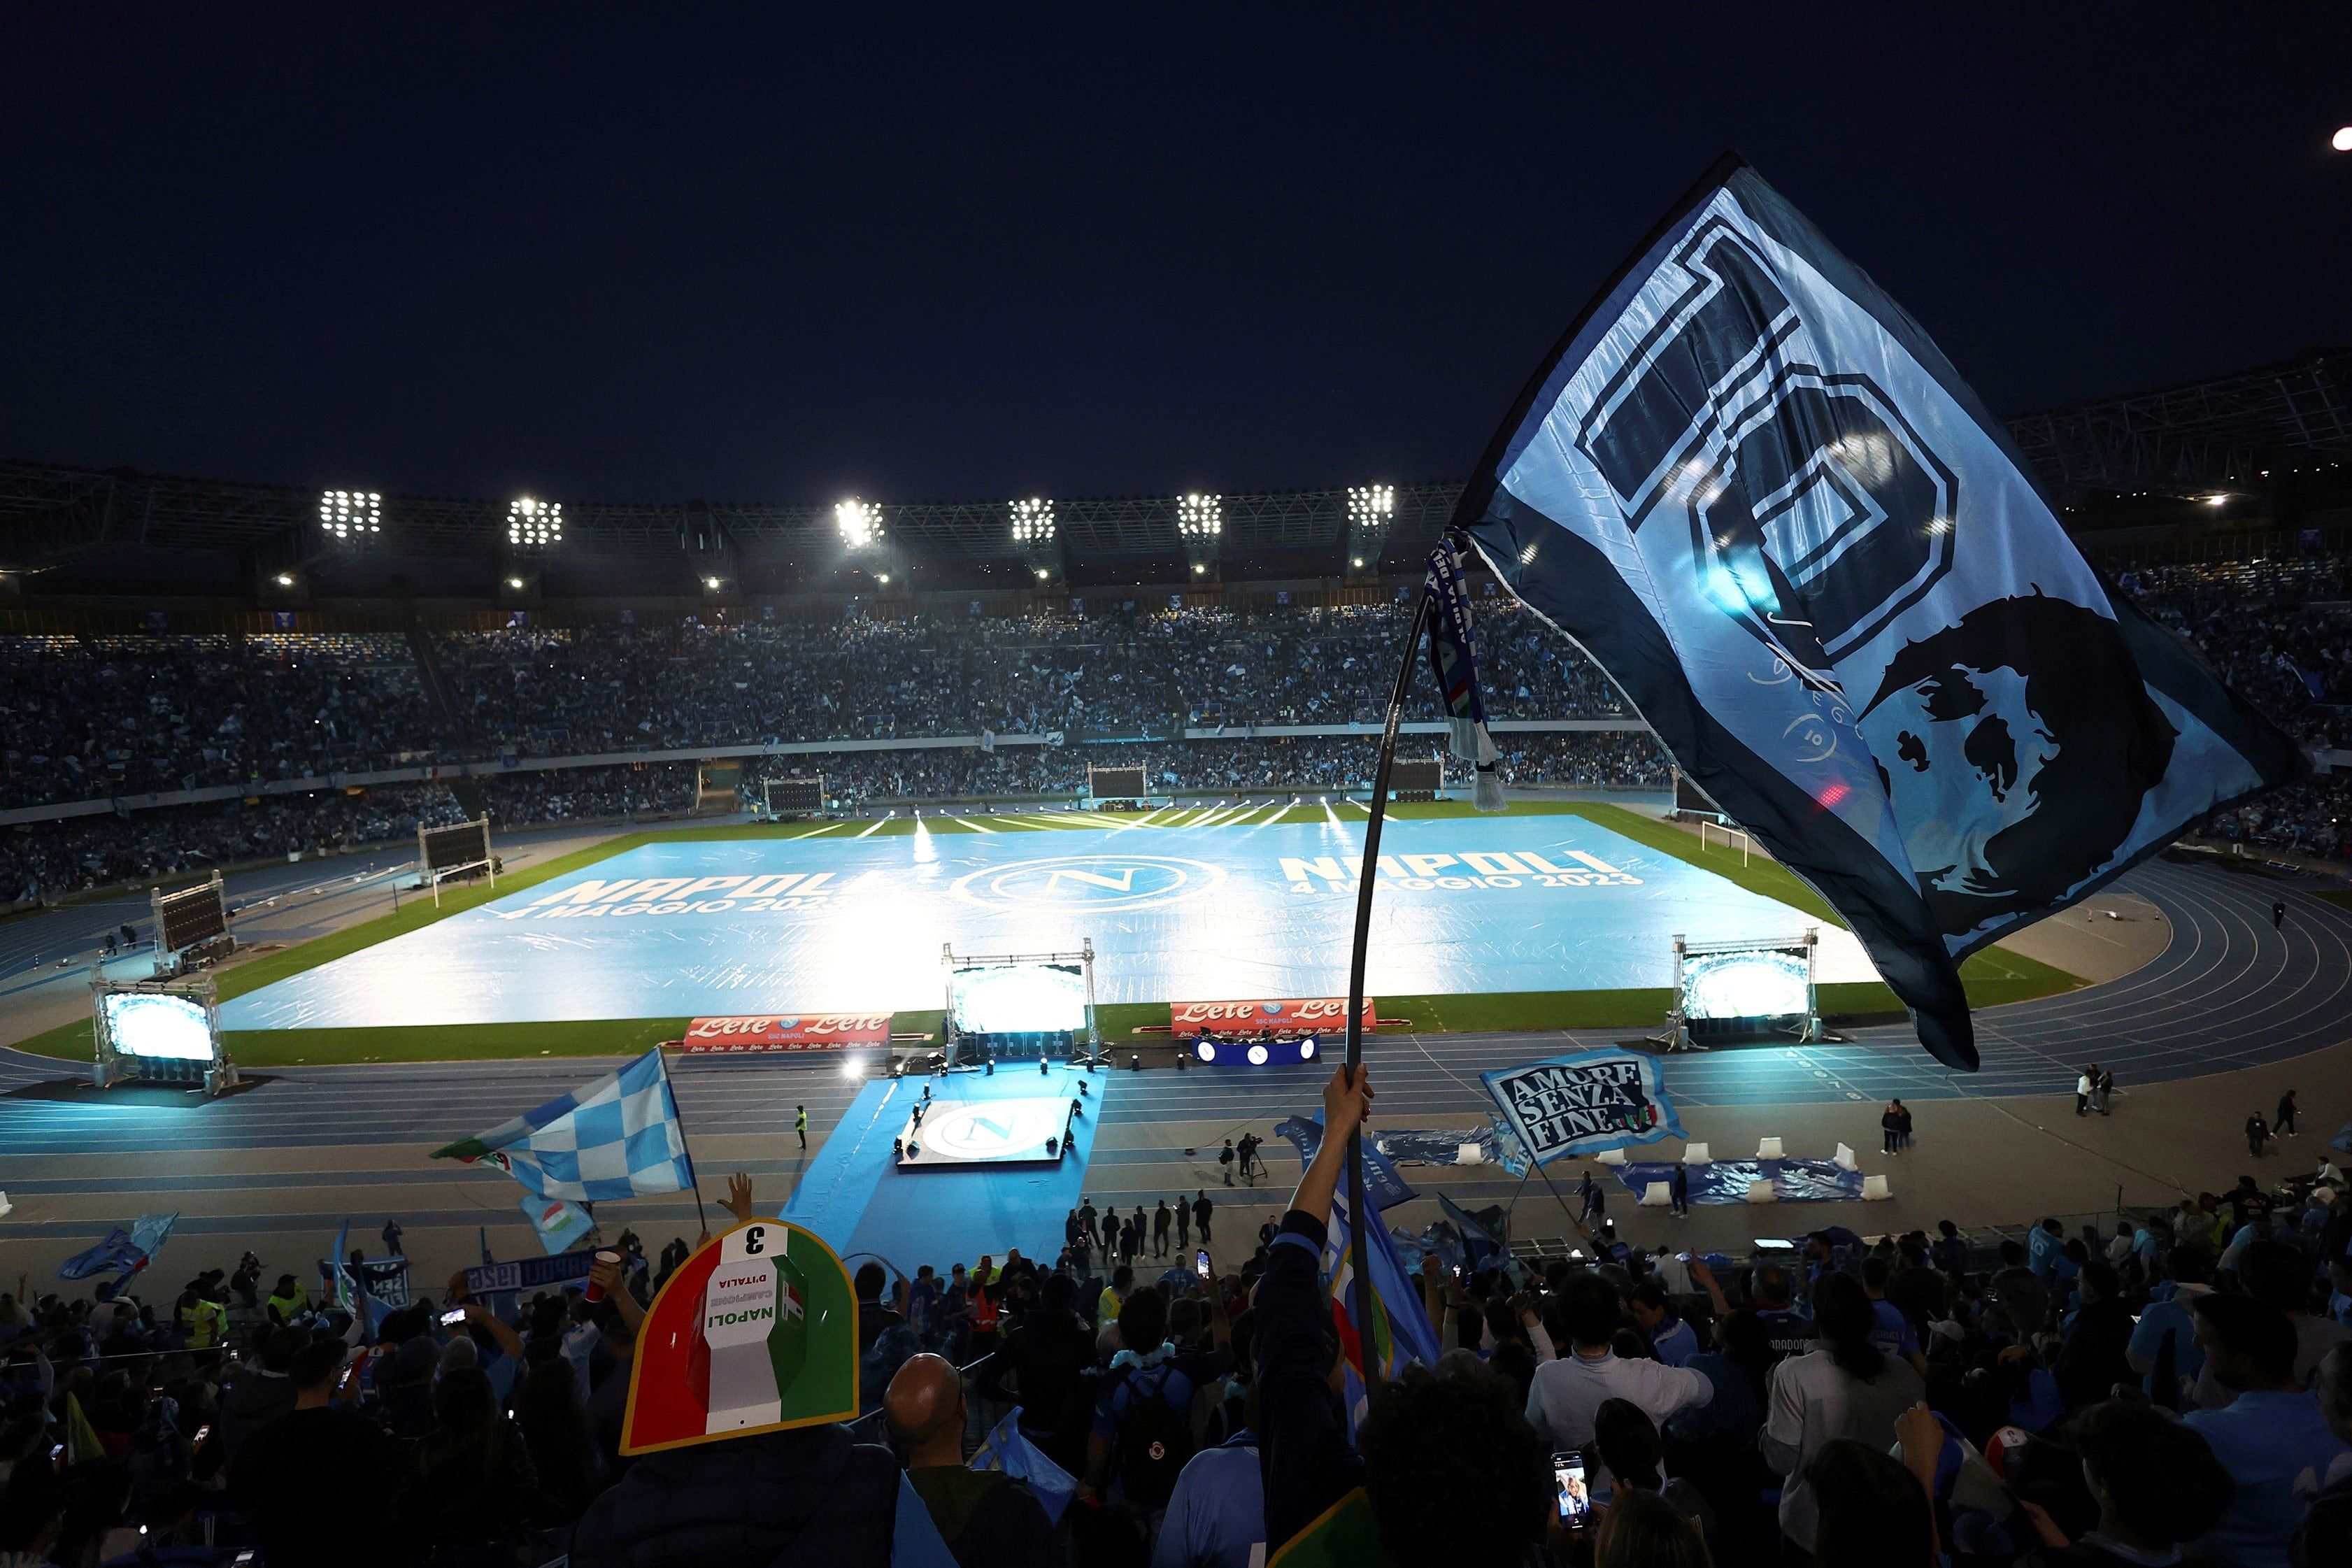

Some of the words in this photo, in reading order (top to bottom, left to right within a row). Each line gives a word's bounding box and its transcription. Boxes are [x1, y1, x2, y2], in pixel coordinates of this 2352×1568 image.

[1574, 213, 1960, 667] 10
[1278, 850, 1620, 882] NAPOLI
[530, 871, 884, 906] NAPOLI
[1290, 880, 1317, 895] 4
[1326, 874, 1523, 894] MAGGIO
[1532, 872, 1644, 888] 2023
[534, 899, 736, 920] MAGGIO
[689, 1017, 771, 1038] Lete
[804, 1013, 884, 1034] Lete
[1175, 1003, 1253, 1024] Lete
[1513, 1064, 1639, 1104] AMORE
[1518, 1083, 1636, 1125] SENZA
[964, 1117, 1015, 1141] N
[1529, 1108, 1613, 1149] FINE
[746, 1226, 765, 1255] 3
[719, 1274, 767, 1288] D'ITALIA
[711, 1290, 773, 1307] CAMPIONE
[708, 1306, 773, 1328] NAPOLI
